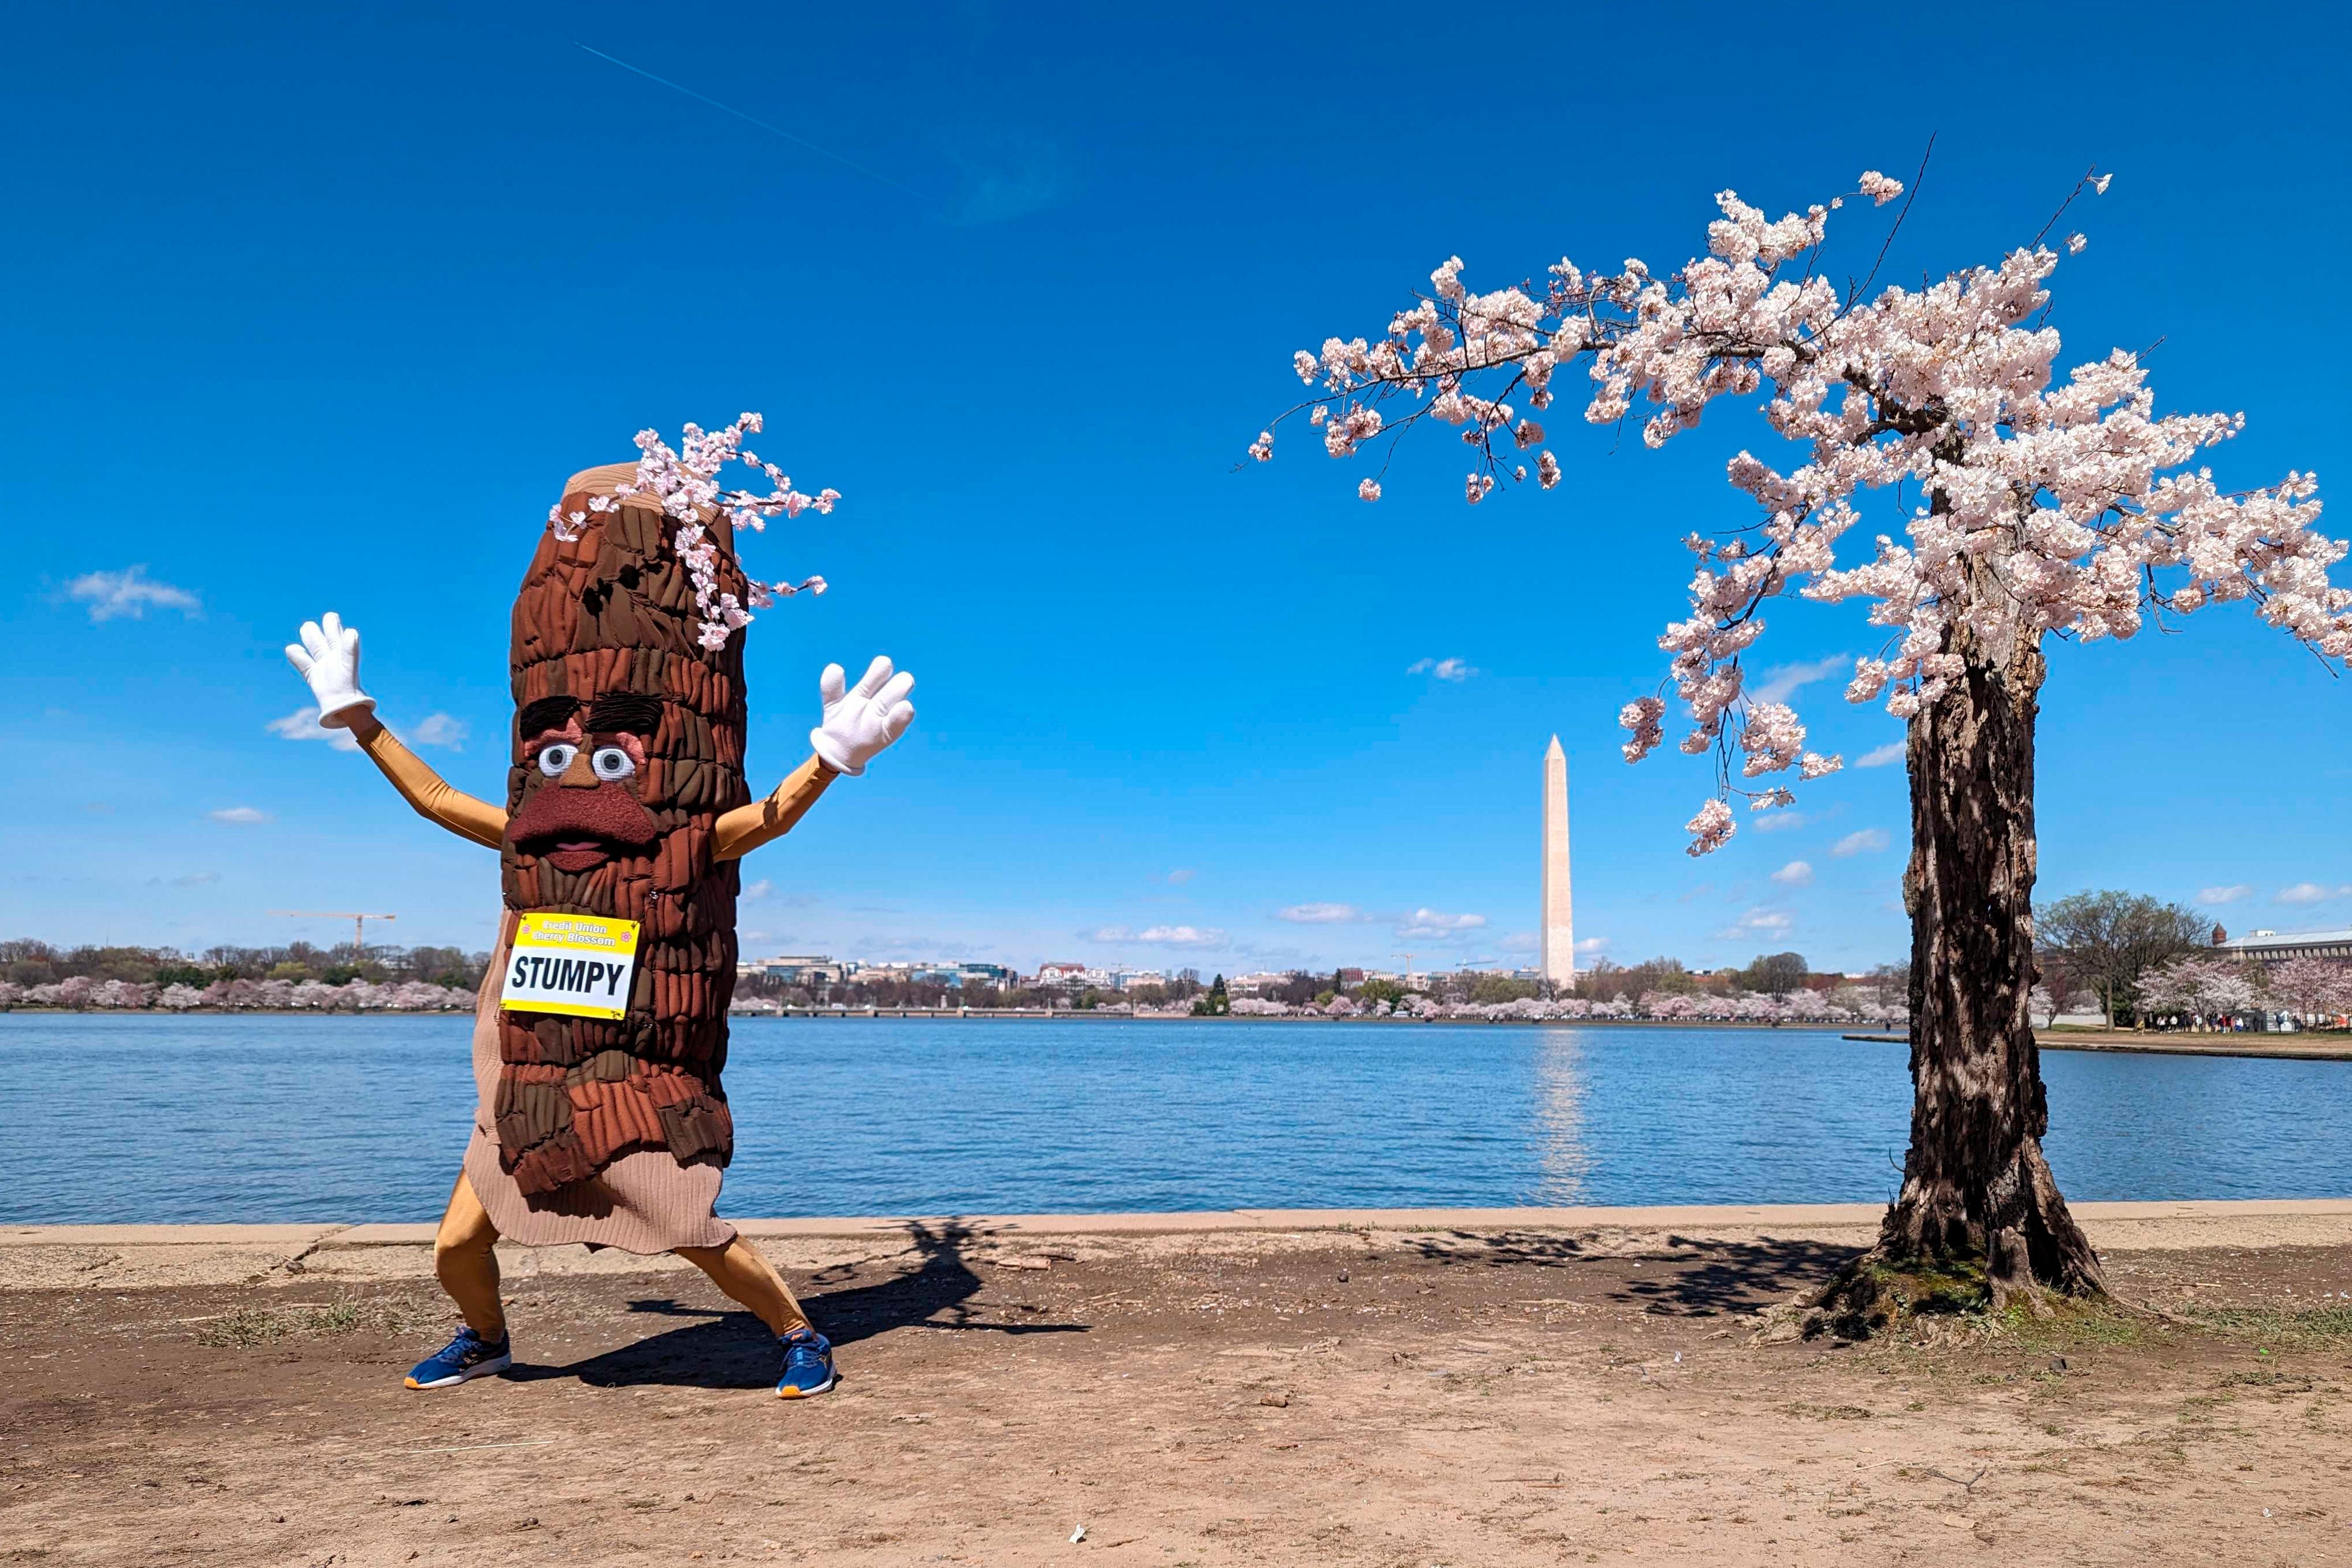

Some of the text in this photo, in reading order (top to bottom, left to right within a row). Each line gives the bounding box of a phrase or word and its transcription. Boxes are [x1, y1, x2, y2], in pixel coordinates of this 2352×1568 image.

[543, 920, 607, 934] Credit Union
[533, 930, 616, 946] Cherry Blossom
[512, 956, 625, 996] STUMPY
